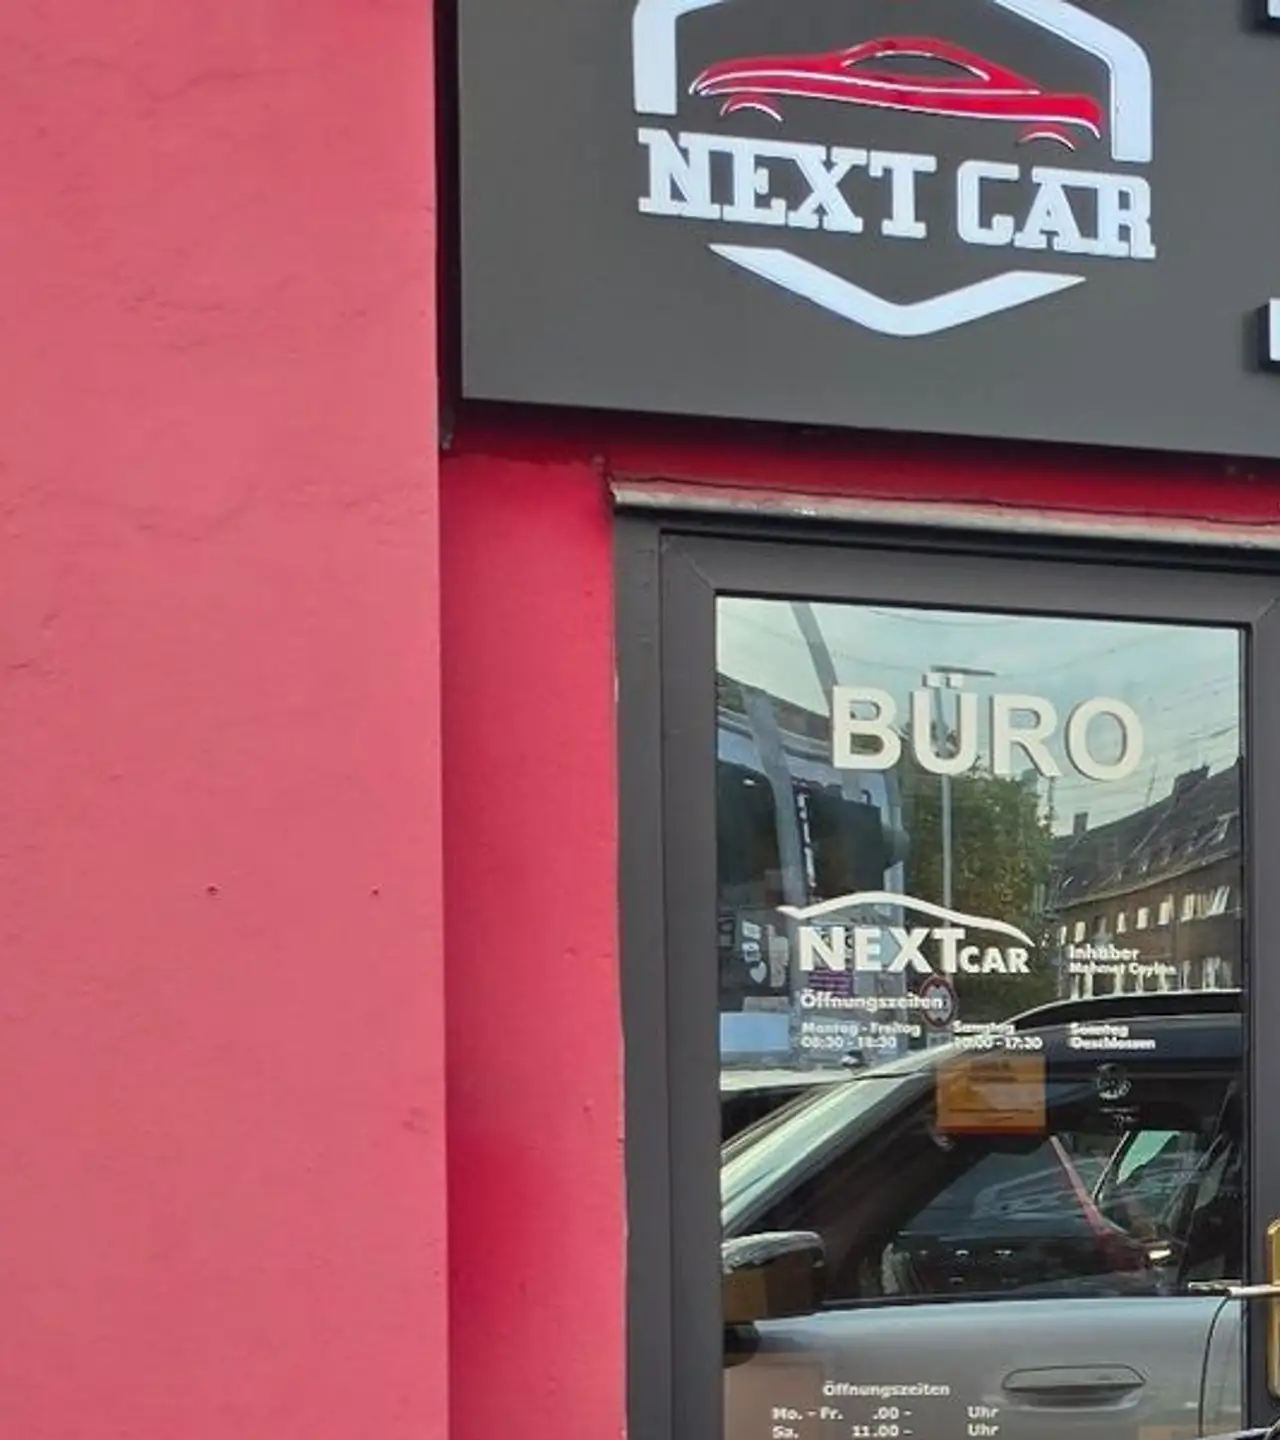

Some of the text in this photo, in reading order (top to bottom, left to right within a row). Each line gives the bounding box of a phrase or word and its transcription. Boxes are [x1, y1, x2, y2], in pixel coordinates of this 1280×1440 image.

[638, 127, 1156, 259] NEXT CAR
[831, 672, 1145, 782] BÜRO
[1069, 943, 1140, 960] Inhaber
[801, 988, 943, 1014] Öffnungszeiten
[801, 1022, 859, 1038] Montag
[870, 1021, 921, 1038] Freitag
[822, 1380, 951, 1399] Öffnungszeiten
[771, 1406, 804, 1421] Mo.
[820, 1405, 845, 1420] Fr.
[966, 1405, 1000, 1420] Uhr
[772, 1425, 800, 1440] Sa.
[966, 1423, 1000, 1438] Uhr
